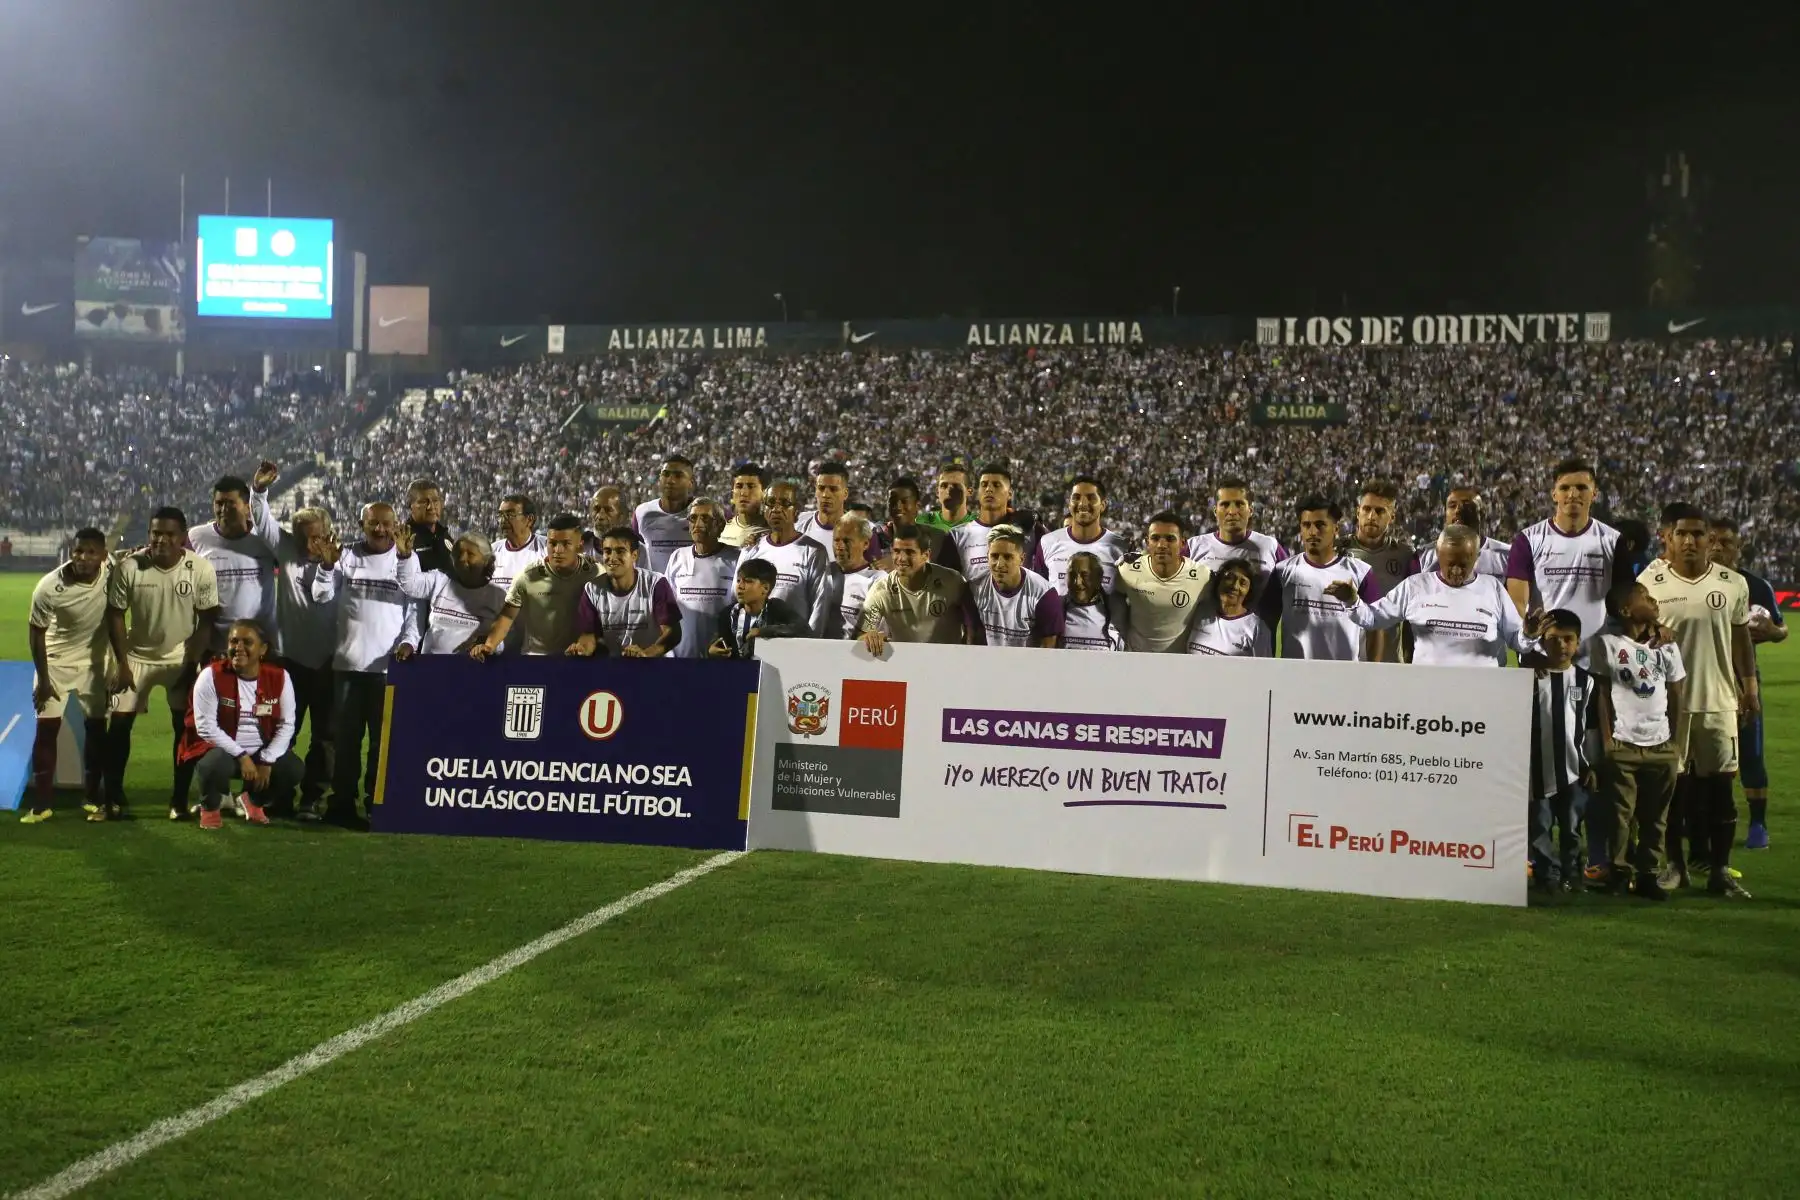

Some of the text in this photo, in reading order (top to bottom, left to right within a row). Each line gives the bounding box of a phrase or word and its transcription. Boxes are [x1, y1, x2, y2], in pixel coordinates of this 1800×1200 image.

[608, 327, 768, 350] ALIANZA LIMA
[967, 322, 1144, 345] ALIANZA LIMA
[1284, 313, 1579, 346] LOS DE ORIENTE
[598, 407, 650, 420] SALIDA
[1266, 405, 1327, 418] SALIDA
[1132, 561, 1140, 570] G
[1189, 569, 1197, 577] G
[1655, 574, 1663, 582] G
[179, 583, 188, 595] U
[1177, 593, 1186, 606] U
[1711, 593, 1721, 607] U
[588, 699, 615, 734] U
[848, 704, 897, 726] PERÚ
[1293, 711, 1486, 737] www.inabif.gob.pe
[950, 717, 1213, 749] LAS CANAS SE RESPETAN
[779, 760, 828, 771] Ministerio
[1293, 749, 1484, 769] Av. San Martín 685, Pueblo Libre
[426, 757, 692, 786] QUE LA VIOLENCIA NO SEA
[778, 772, 842, 786] de la Mujer y
[980, 766, 1060, 791] MEREZCO
[1067, 768, 1093, 792] UN
[1101, 768, 1151, 793] BUEN
[1157, 769, 1227, 795] TRATO!
[1316, 766, 1458, 785] Teléfono: (01) 417-6720
[425, 785, 691, 818] UN CLÁSICO EN EL FÚTBOL.
[777, 784, 896, 800] Poblaciones Vulnerables
